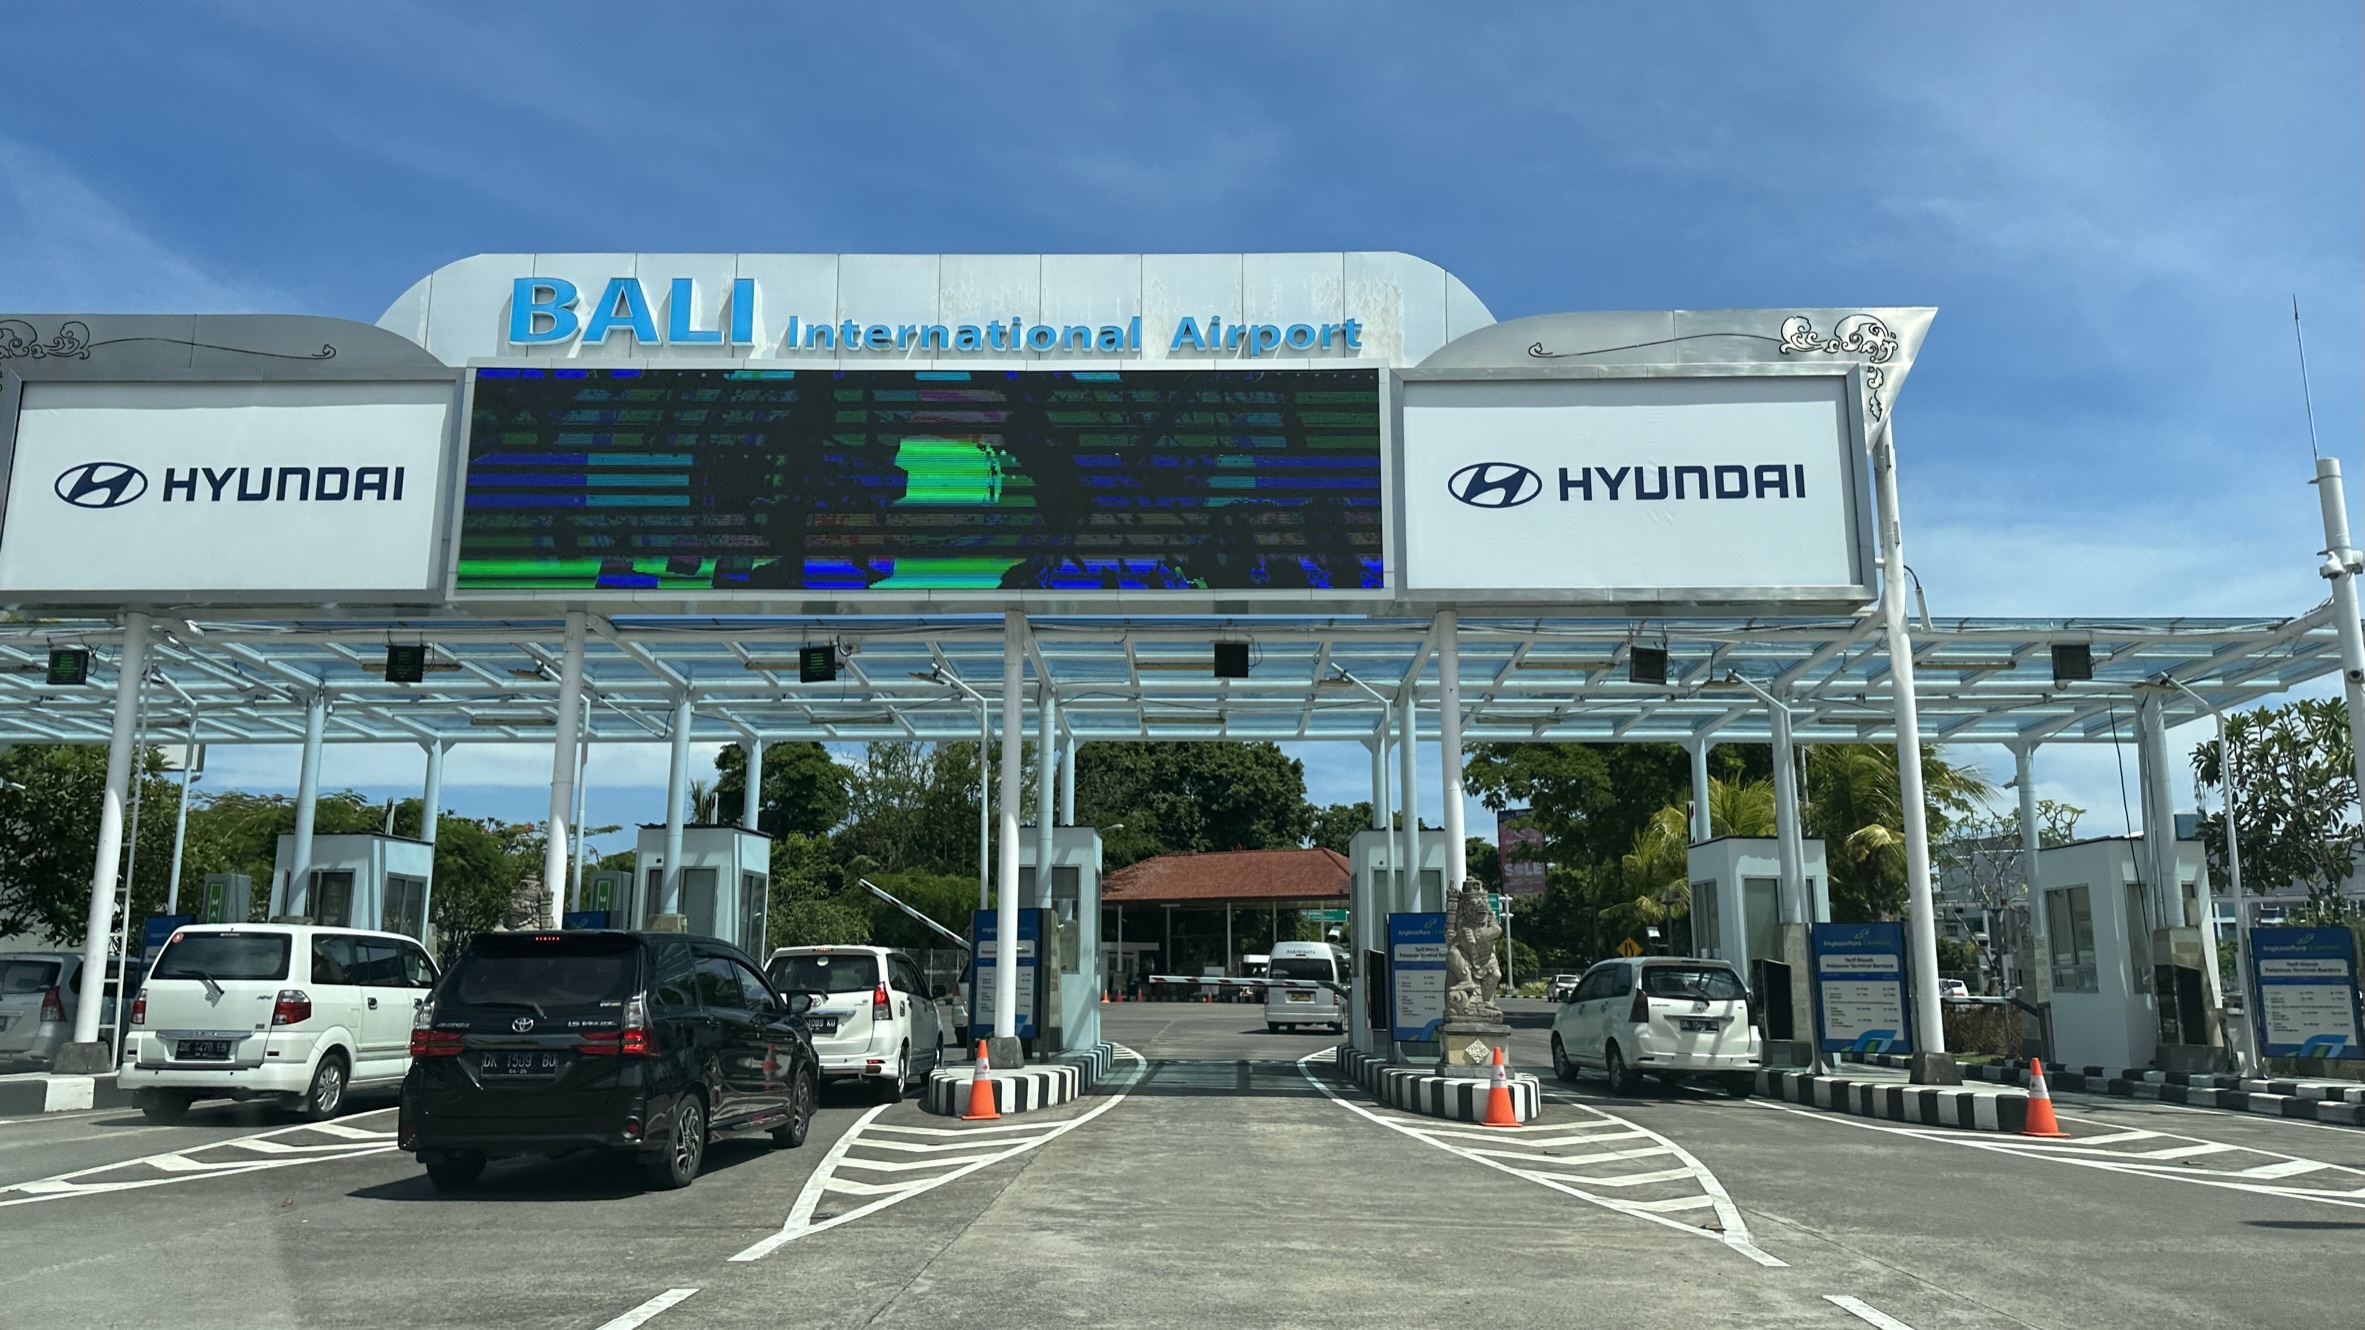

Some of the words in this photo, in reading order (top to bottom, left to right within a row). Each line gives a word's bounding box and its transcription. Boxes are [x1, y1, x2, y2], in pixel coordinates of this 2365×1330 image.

[508, 277, 758, 347] BALI
[787, 315, 1142, 351] International
[1169, 316, 1363, 358] Airport
[162, 466, 405, 502] HYUNDAI
[1558, 463, 1806, 501] HYUNDAI
[483, 1054, 498, 1068] DK
[507, 1054, 532, 1068] 1509
